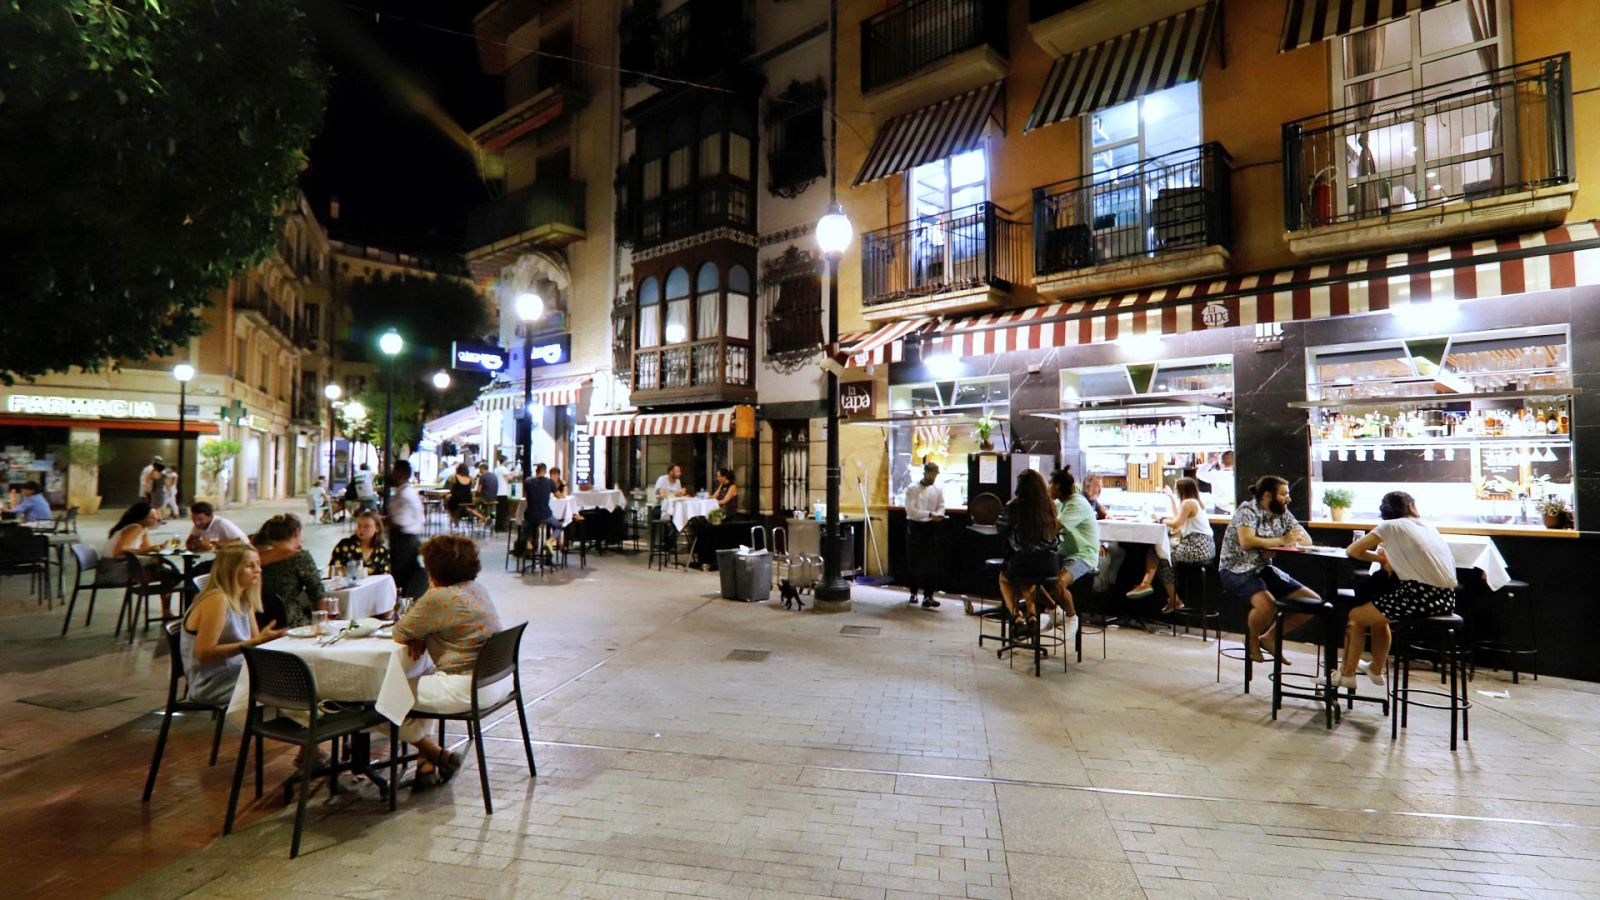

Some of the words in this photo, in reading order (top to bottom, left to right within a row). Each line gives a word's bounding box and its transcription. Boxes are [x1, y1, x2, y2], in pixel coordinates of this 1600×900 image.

[848, 385, 857, 396] la
[8, 395, 157, 418] FARMACIA
[841, 394, 871, 413] tapa
